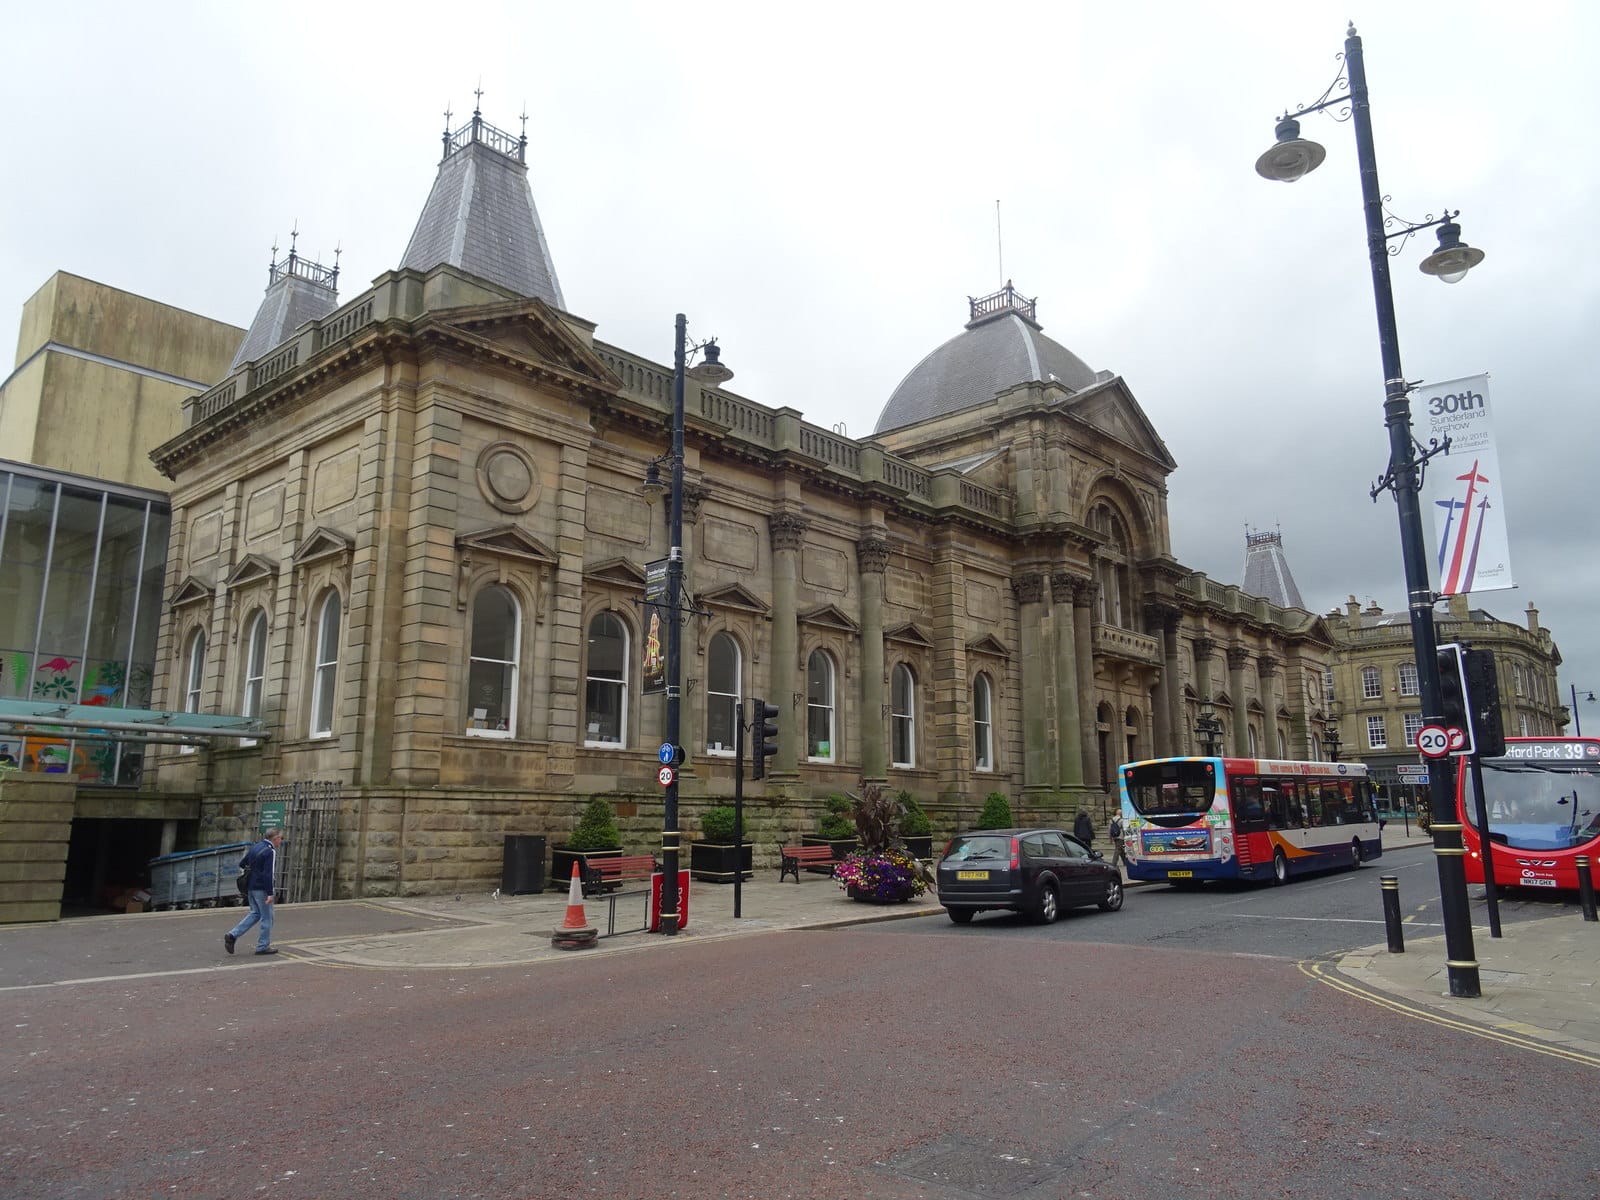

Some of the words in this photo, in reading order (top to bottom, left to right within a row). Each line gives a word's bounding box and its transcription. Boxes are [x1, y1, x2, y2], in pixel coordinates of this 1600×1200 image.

[1428, 390, 1484, 416] 30th
[1430, 408, 1486, 426] Sunderland
[1431, 422, 1471, 434] Airshow
[1422, 734, 1447, 748] 20
[1504, 745, 1533, 758] xford
[1534, 745, 1561, 758] Park
[1564, 743, 1584, 760] 39
[660, 771, 671, 781] 20
[1521, 869, 1535, 878] Go
